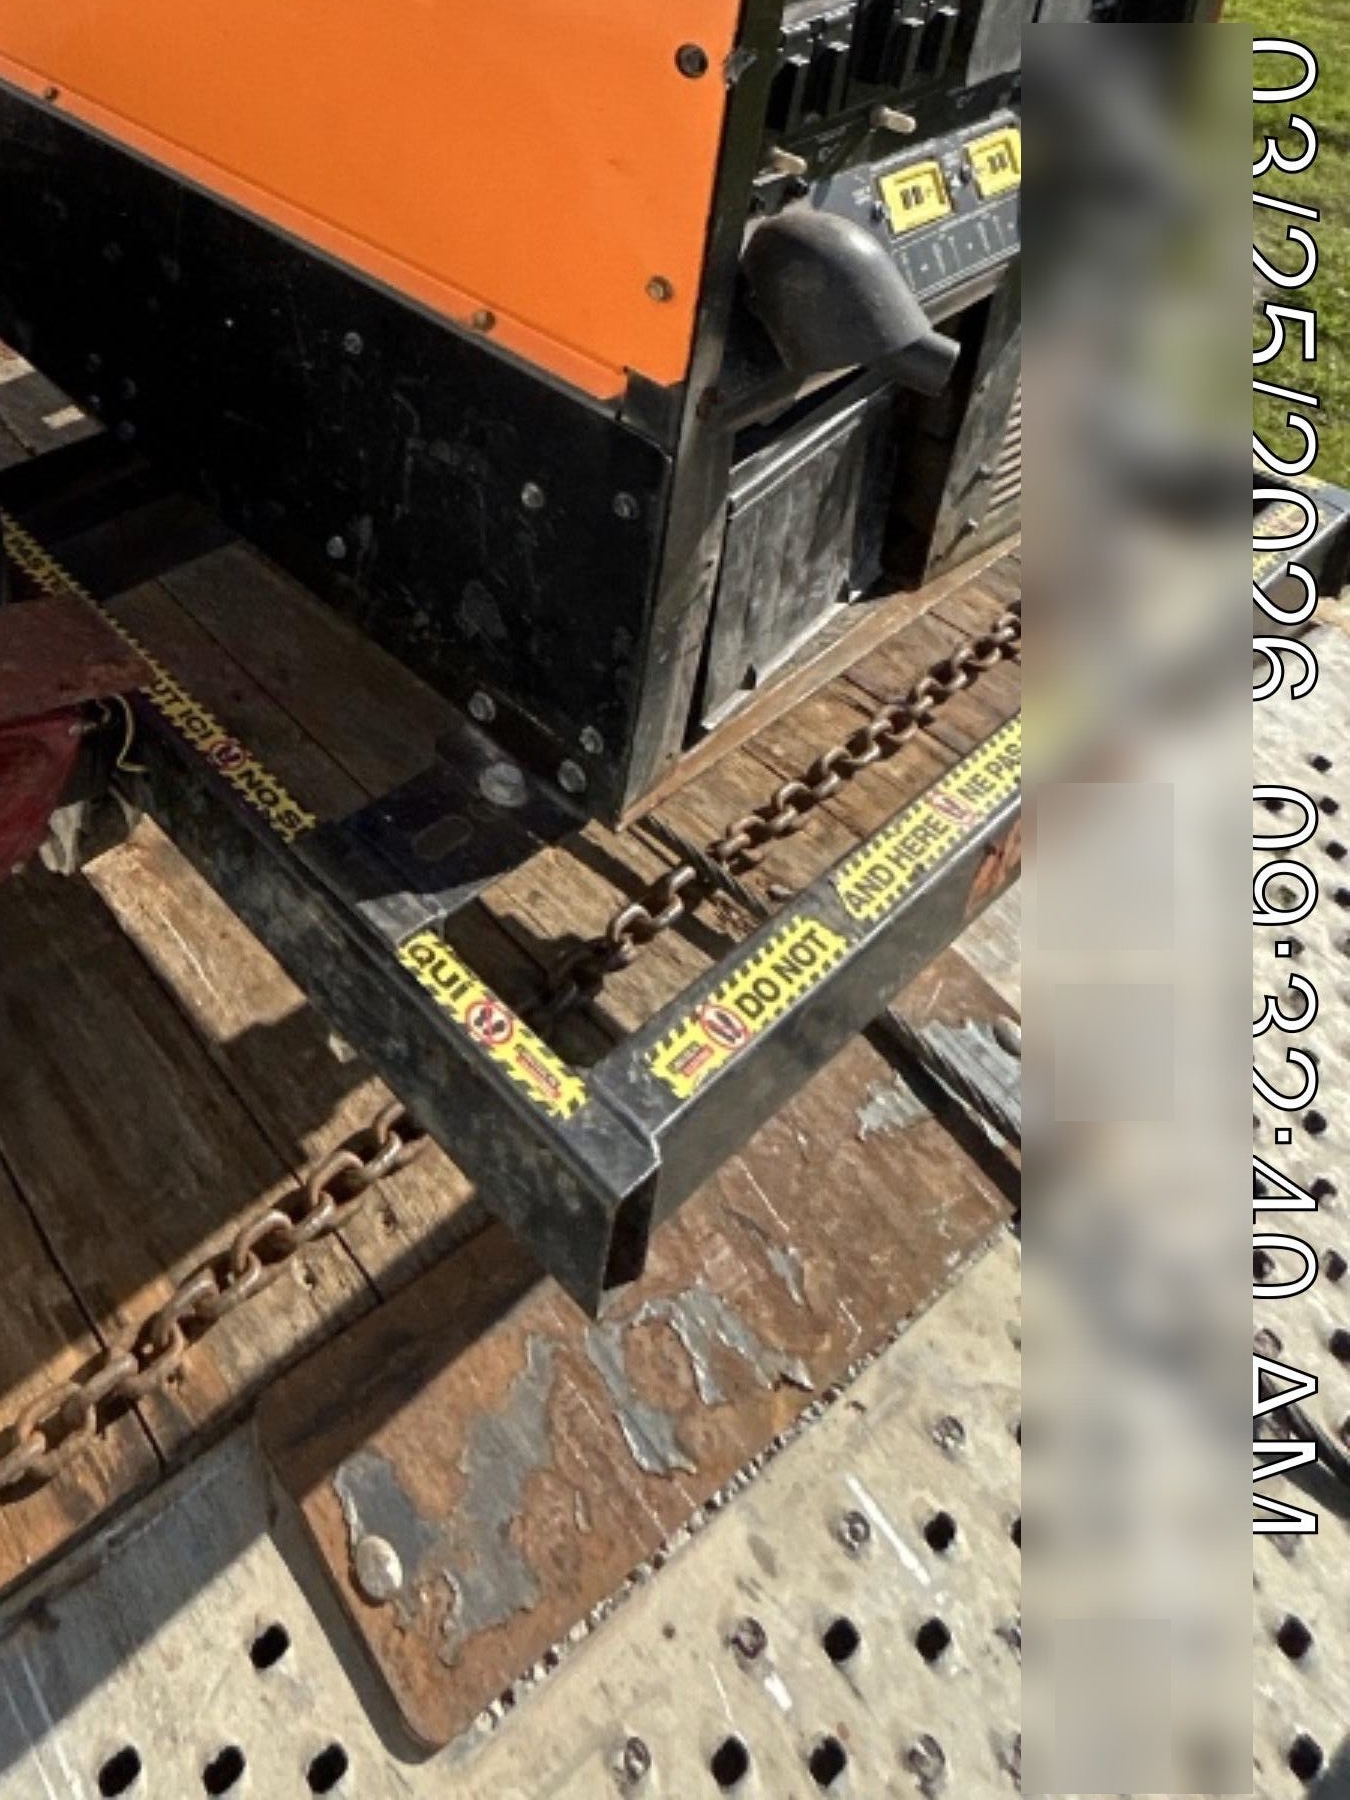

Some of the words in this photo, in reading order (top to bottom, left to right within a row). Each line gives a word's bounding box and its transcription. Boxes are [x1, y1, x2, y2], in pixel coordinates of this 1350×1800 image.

[955, 771, 998, 802] NE
[843, 861, 897, 914] AND
[885, 814, 950, 871] HERE
[736, 974, 780, 1022] DO
[778, 929, 833, 988] NOT
